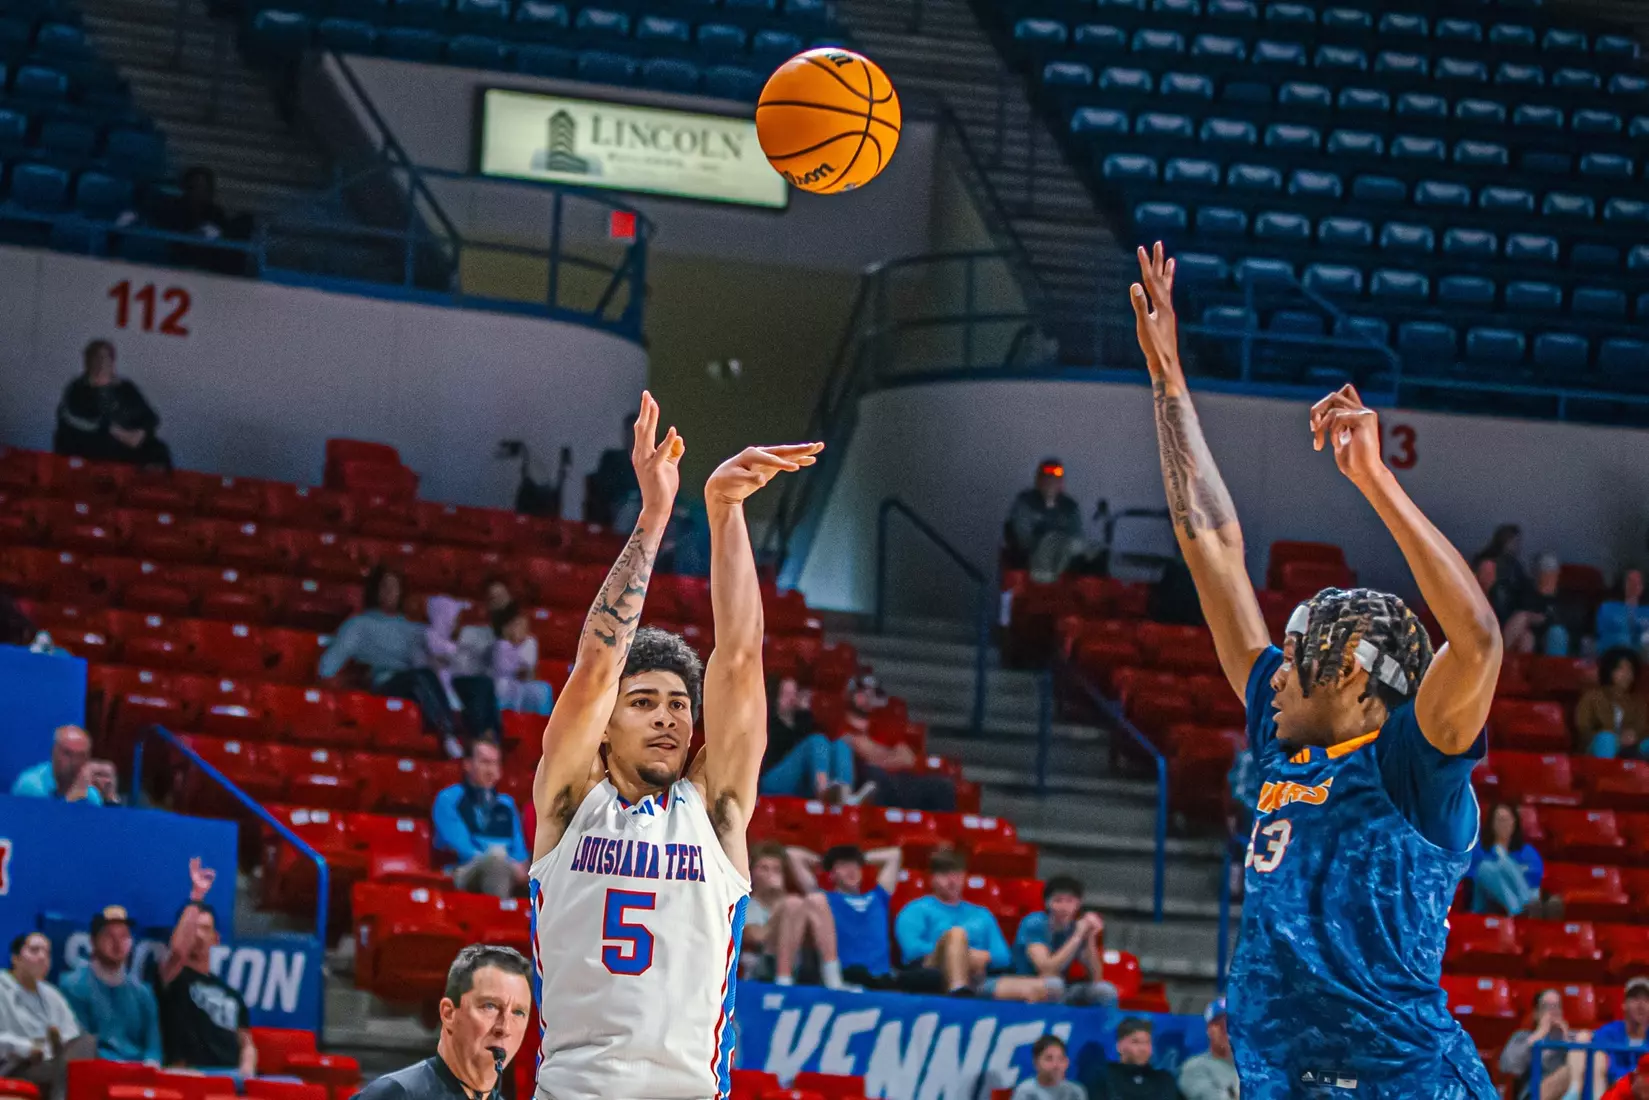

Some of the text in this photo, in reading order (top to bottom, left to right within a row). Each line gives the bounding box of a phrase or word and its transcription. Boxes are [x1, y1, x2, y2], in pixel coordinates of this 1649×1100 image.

[591, 113, 742, 160] LINCOLN
[108, 280, 191, 336] 112
[570, 835, 660, 880] LOUISIANA
[601, 887, 657, 976] 5
